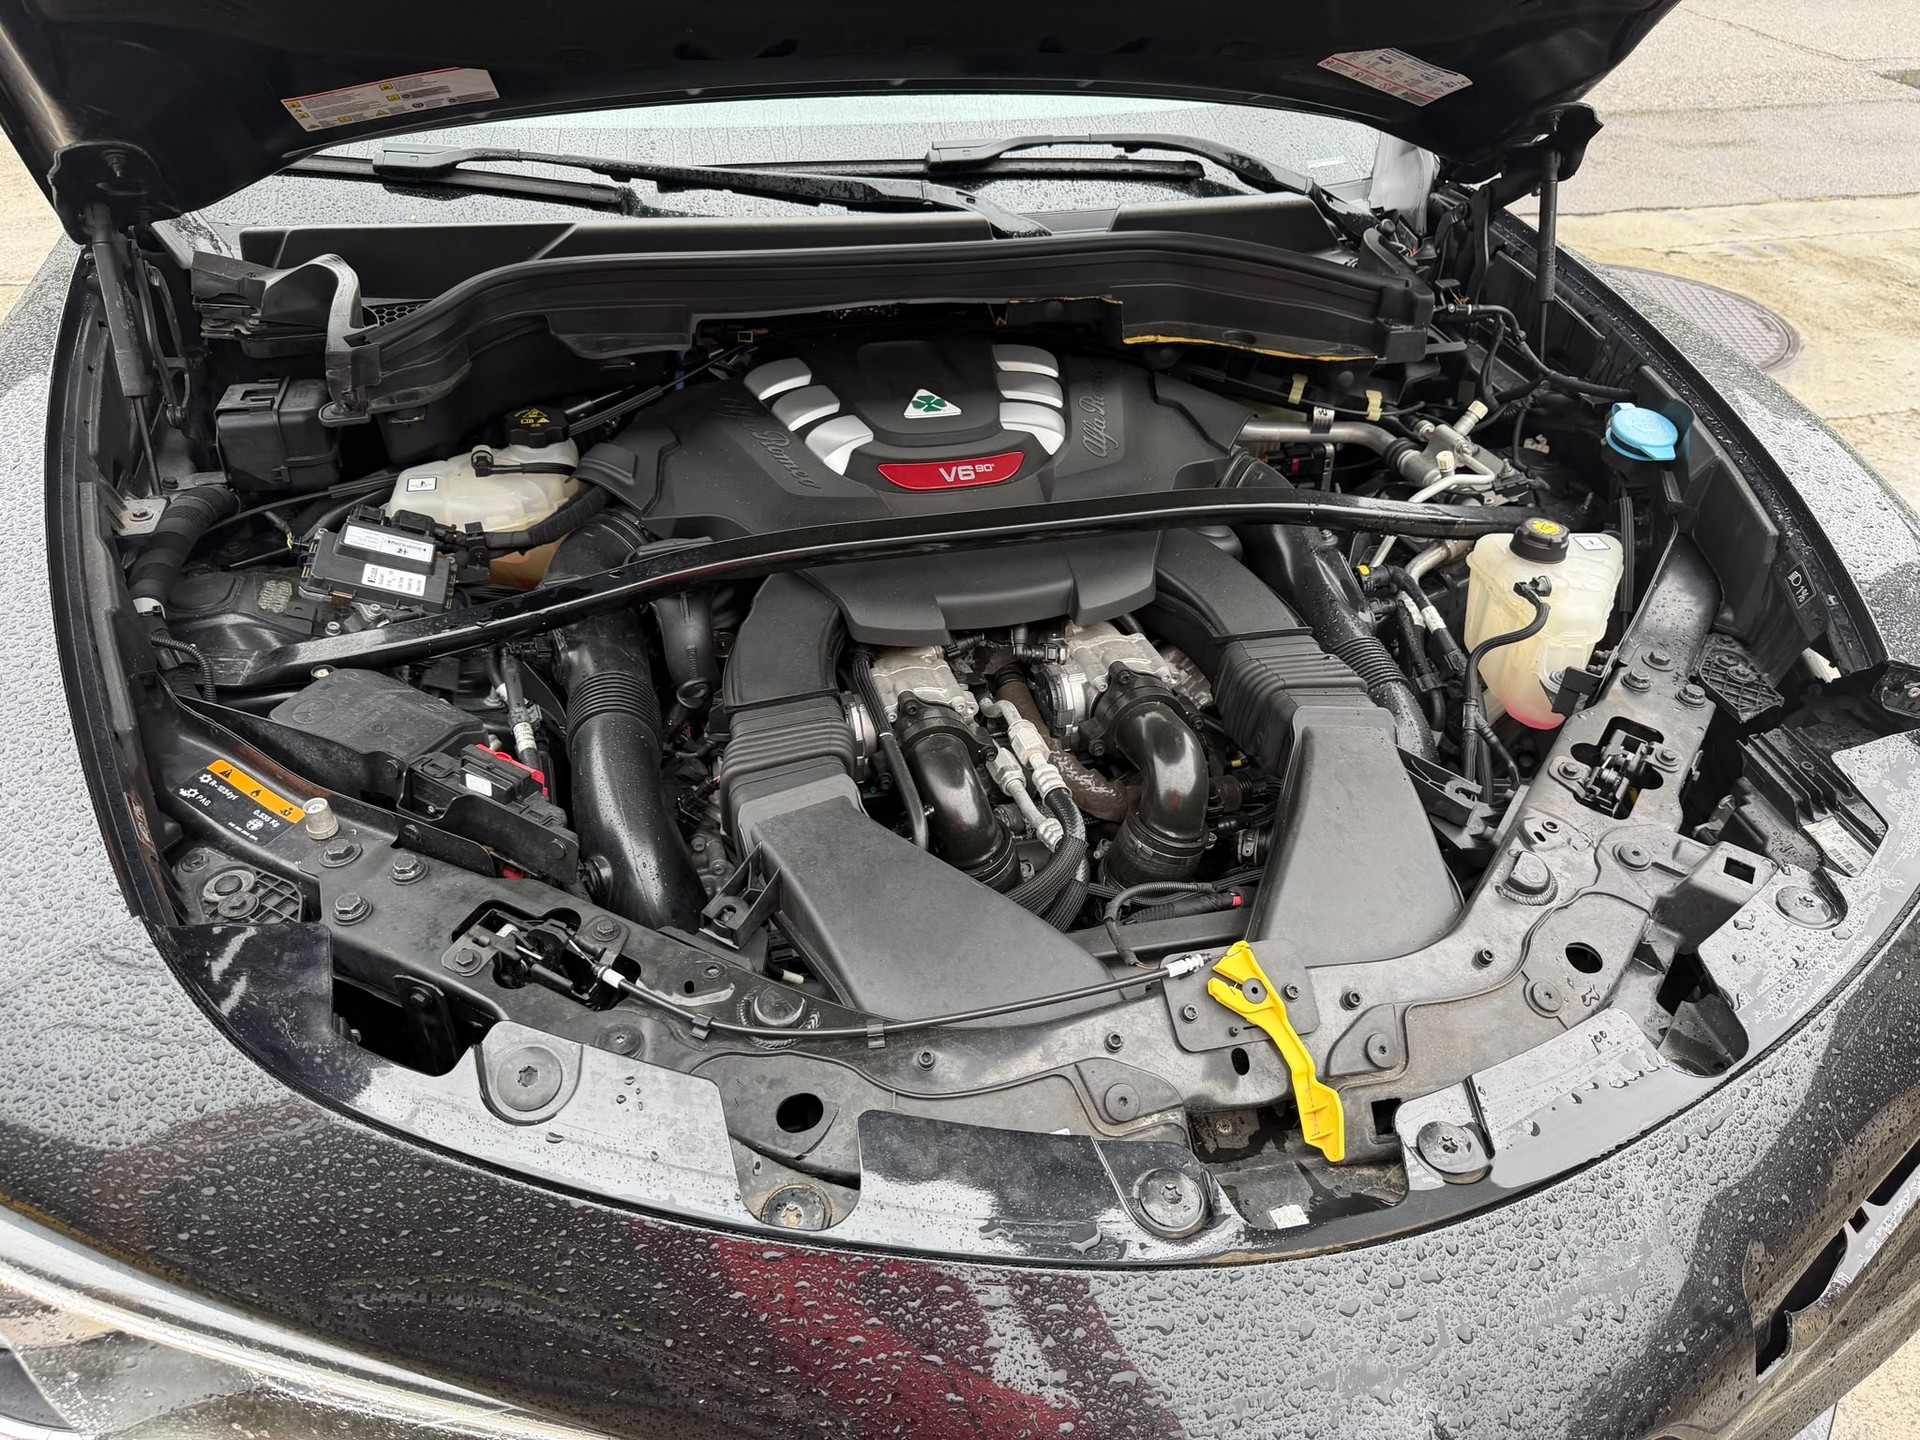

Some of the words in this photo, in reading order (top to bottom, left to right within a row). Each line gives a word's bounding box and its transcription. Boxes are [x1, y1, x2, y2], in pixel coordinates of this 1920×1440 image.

[1079, 365, 1104, 415] Rom
[1082, 414, 1118, 457] Alfa
[751, 431, 822, 489] Romeo
[939, 465, 976, 482] V6
[209, 780, 239, 800] R-1234yf
[196, 795, 211, 806] PAG
[269, 819, 280, 828] Kg
